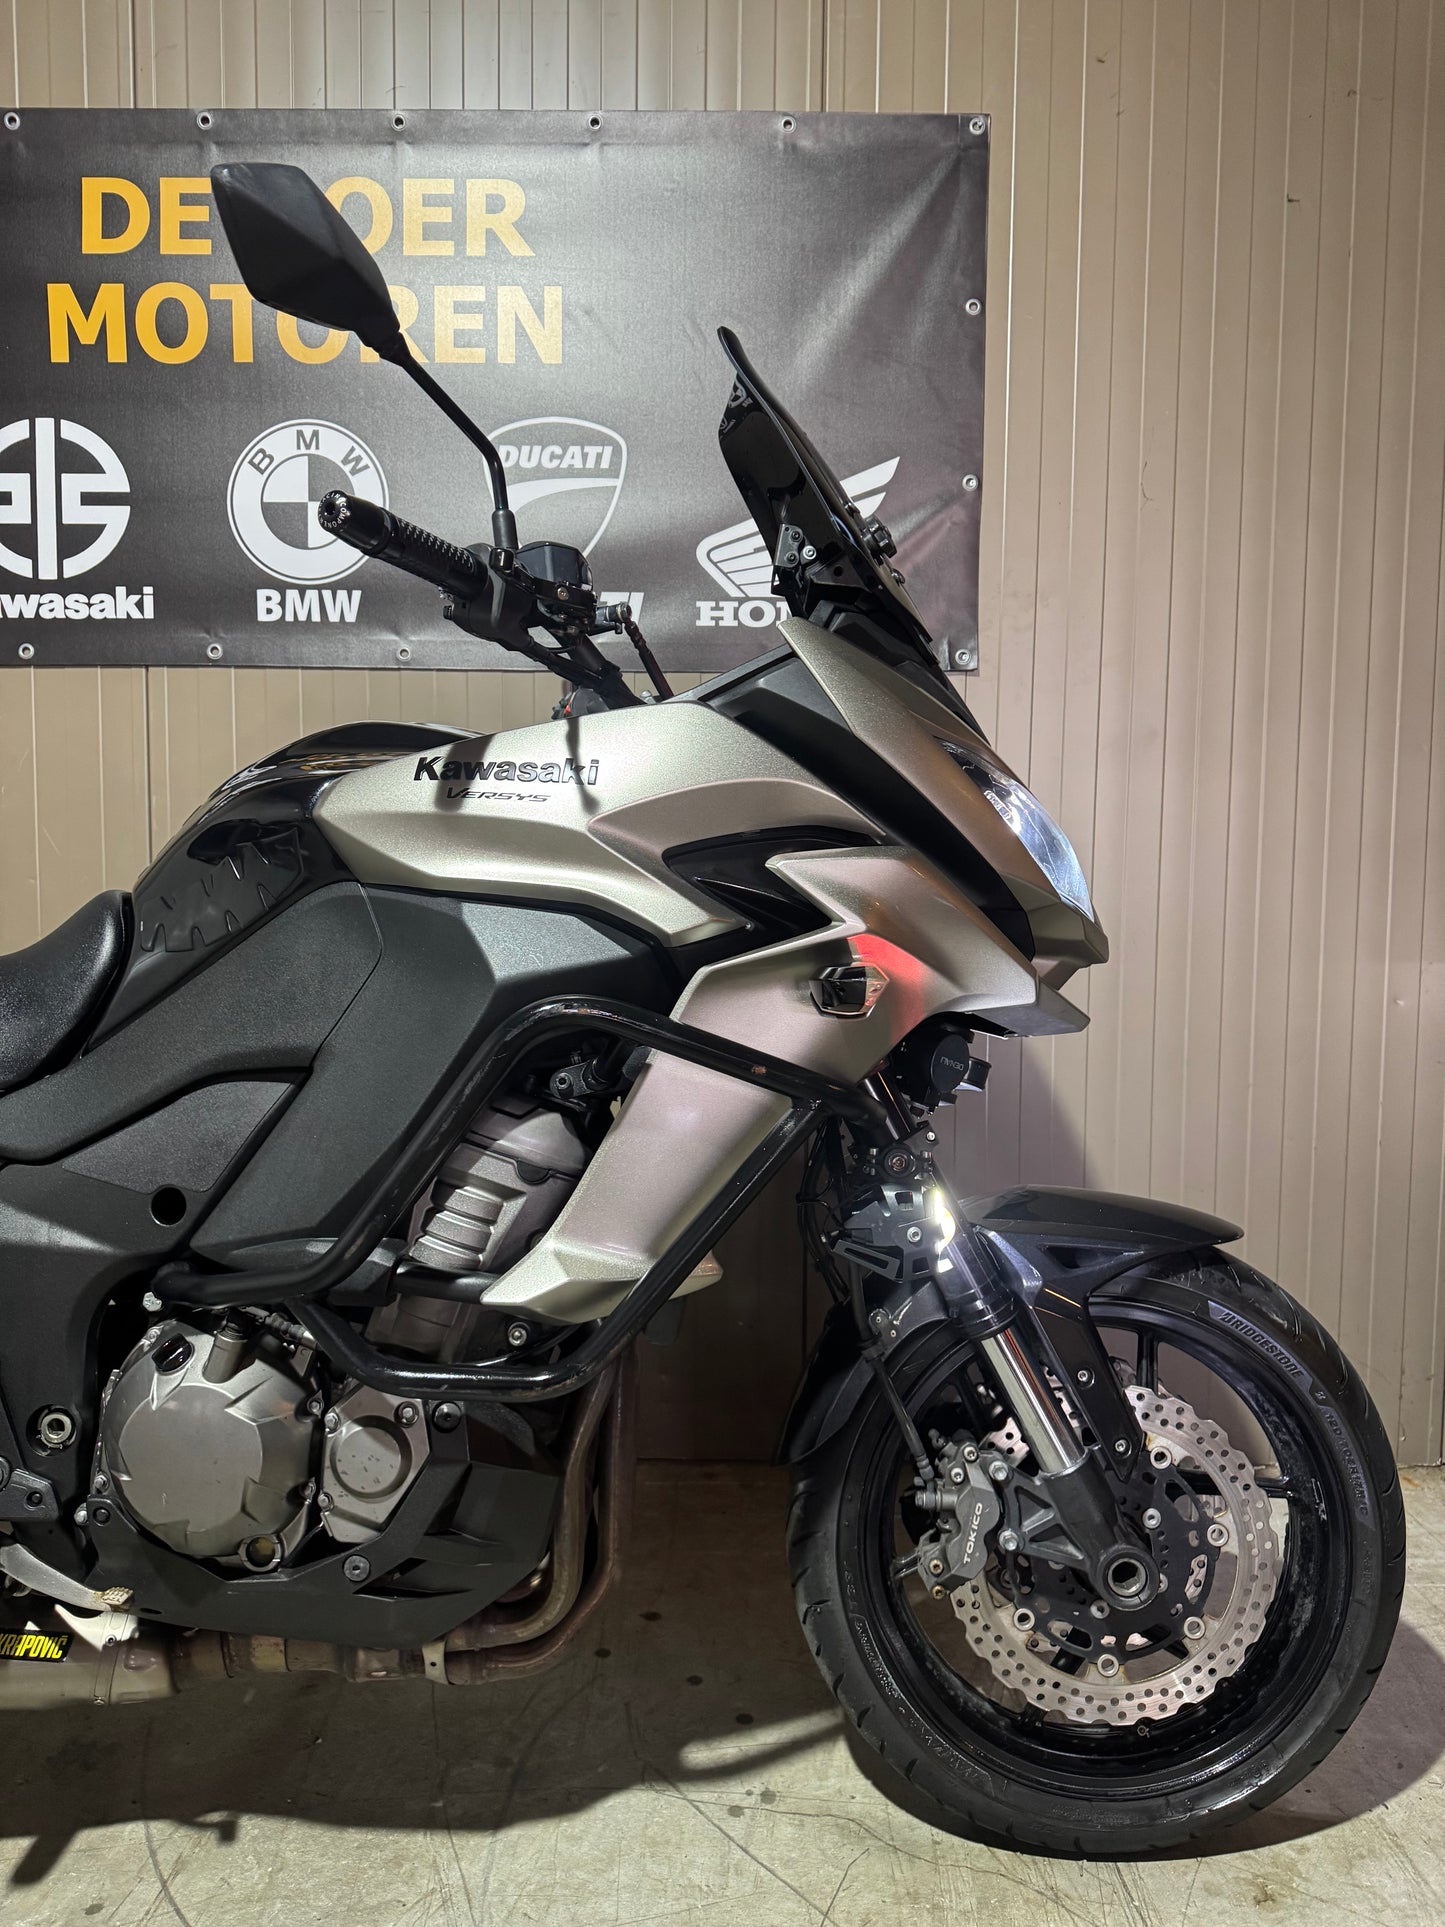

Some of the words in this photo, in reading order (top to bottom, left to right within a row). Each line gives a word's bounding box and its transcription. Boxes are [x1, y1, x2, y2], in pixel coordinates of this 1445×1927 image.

[81, 176, 213, 256] DE
[324, 176, 535, 257] OER
[248, 429, 371, 476] BMW
[498, 445, 613, 469] DUCATI
[0, 586, 155, 620] wasaki
[255, 588, 363, 622] BMW
[413, 756, 600, 786] Kawasaki
[446, 787, 552, 803] VERSYS
[1218, 1310, 1306, 1380] BRIDGESTONE
[962, 1502, 983, 1566] TOKICO
